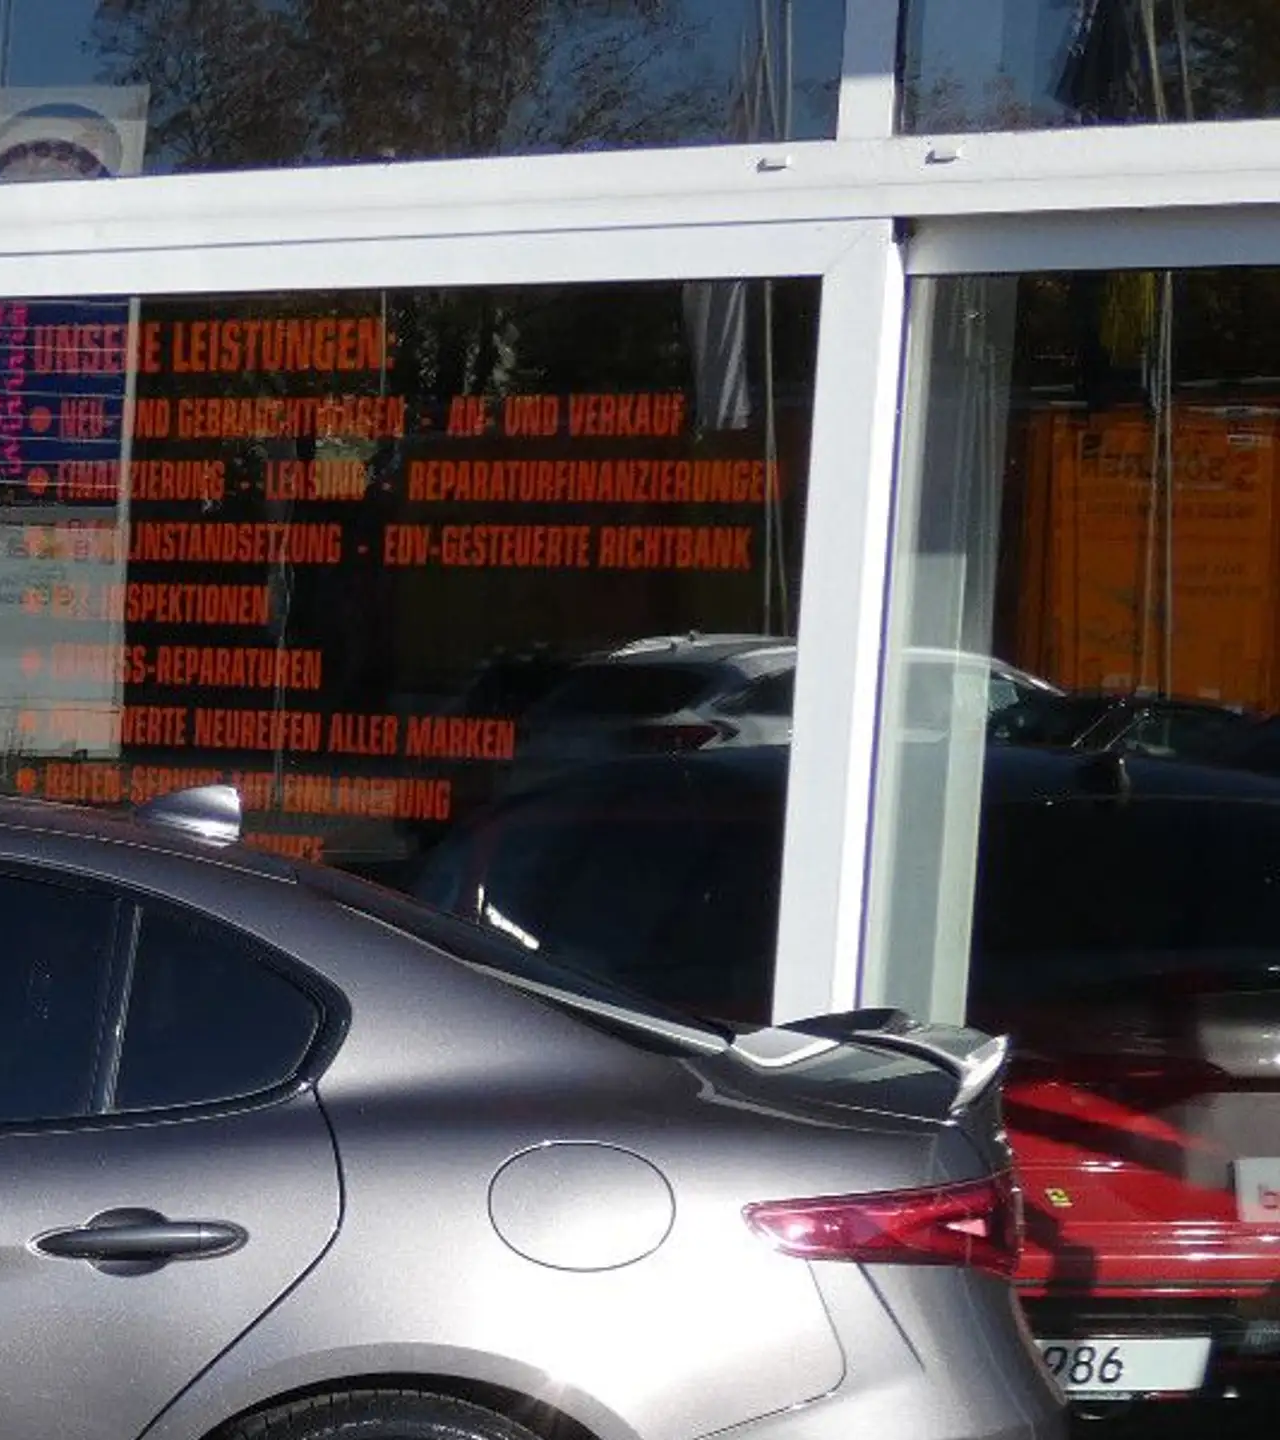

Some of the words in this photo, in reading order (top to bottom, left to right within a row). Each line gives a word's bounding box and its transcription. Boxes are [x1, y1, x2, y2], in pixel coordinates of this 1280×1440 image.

[505, 395, 557, 436] UND
[569, 393, 684, 436] VERKAUF
[598, 525, 752, 568] RICHTBANK
[194, 708, 322, 751] NEUREIFEN
[328, 713, 399, 755] ALLER
[406, 716, 515, 760] MARKEN
